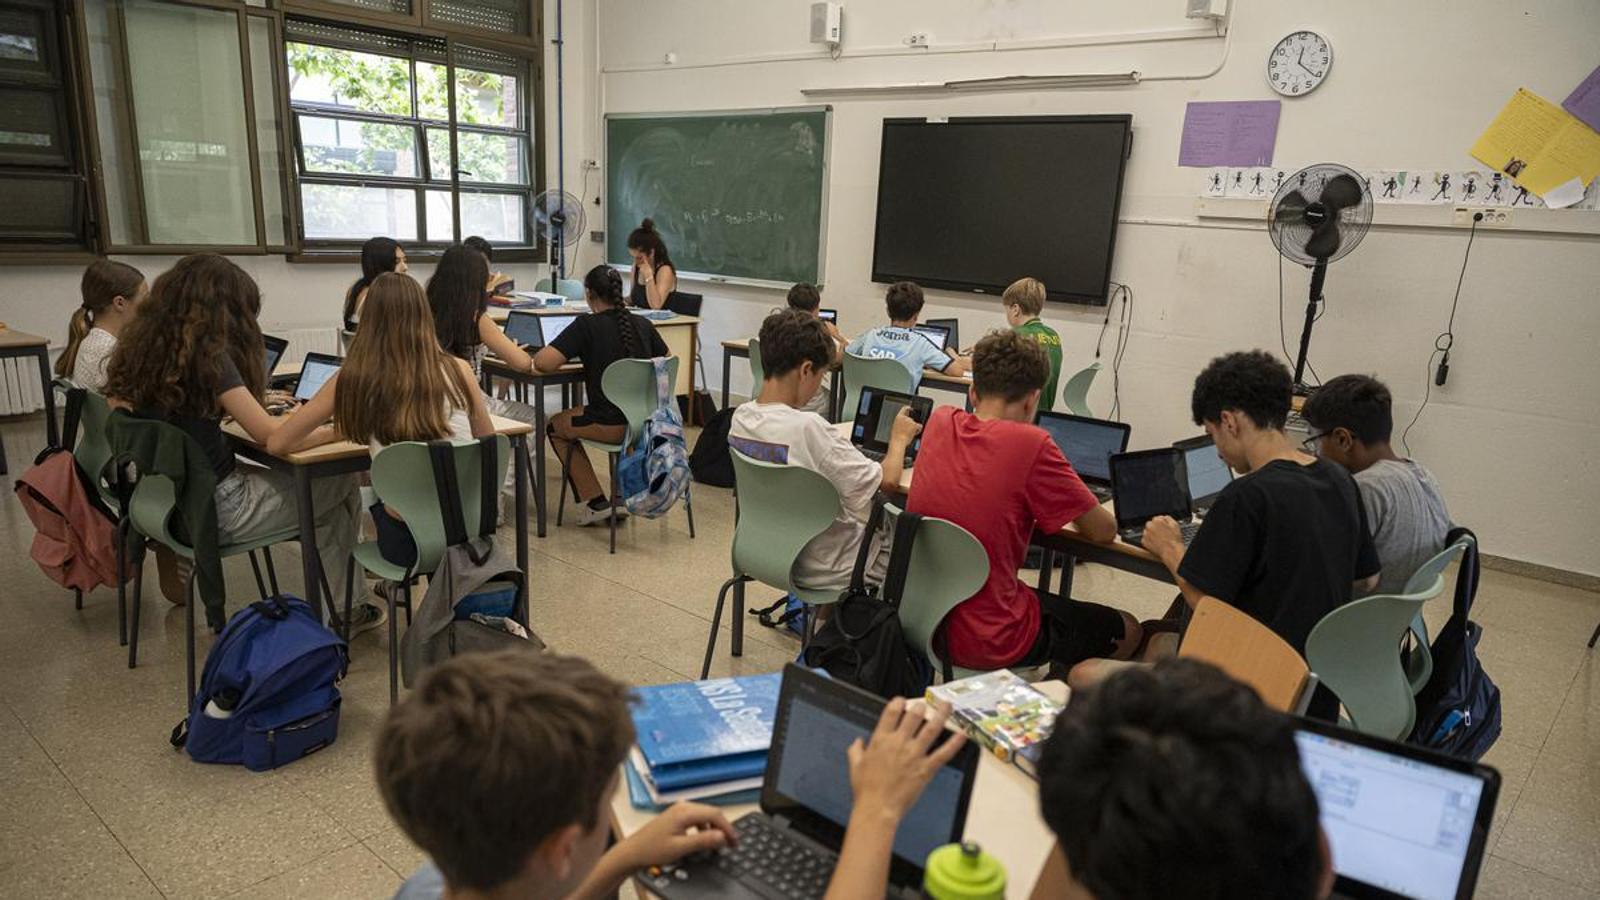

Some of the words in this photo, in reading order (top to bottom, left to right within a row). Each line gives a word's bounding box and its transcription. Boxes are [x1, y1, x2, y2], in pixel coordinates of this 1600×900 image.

[1286, 38, 1293, 46] 11
[1320, 43, 1327, 52] 2
[1276, 48, 1286, 56] 10
[1271, 60, 1278, 68] 9
[1322, 56, 1329, 65] 3
[1272, 73, 1280, 81] 8
[1280, 82, 1288, 90] 7
[1305, 80, 1312, 89] 5
[1291, 85, 1299, 93] 6
